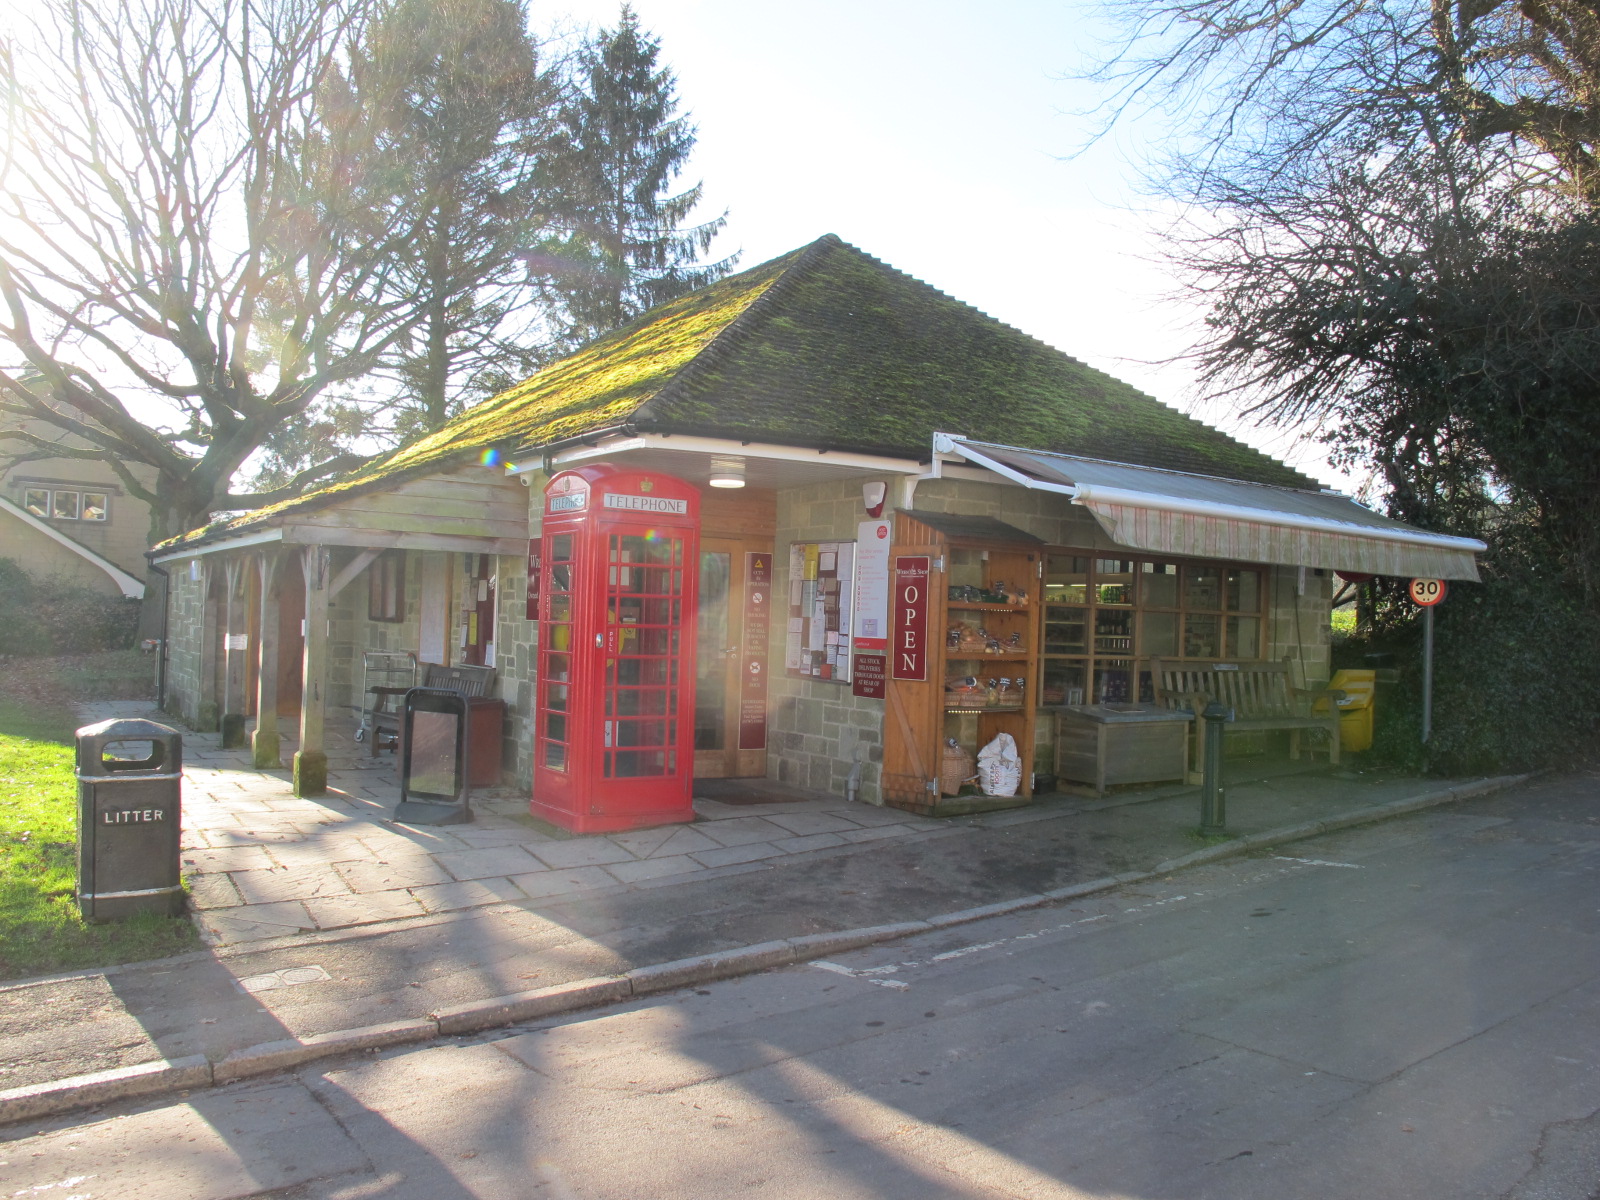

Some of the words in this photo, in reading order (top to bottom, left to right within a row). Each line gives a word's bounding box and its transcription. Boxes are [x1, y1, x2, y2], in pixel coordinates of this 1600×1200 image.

[552, 495, 584, 510] TELEPHO
[608, 495, 684, 513] TELEPHONE
[1415, 581, 1438, 595] 30
[902, 586, 918, 671] OPEN
[105, 809, 164, 824] LITTER
